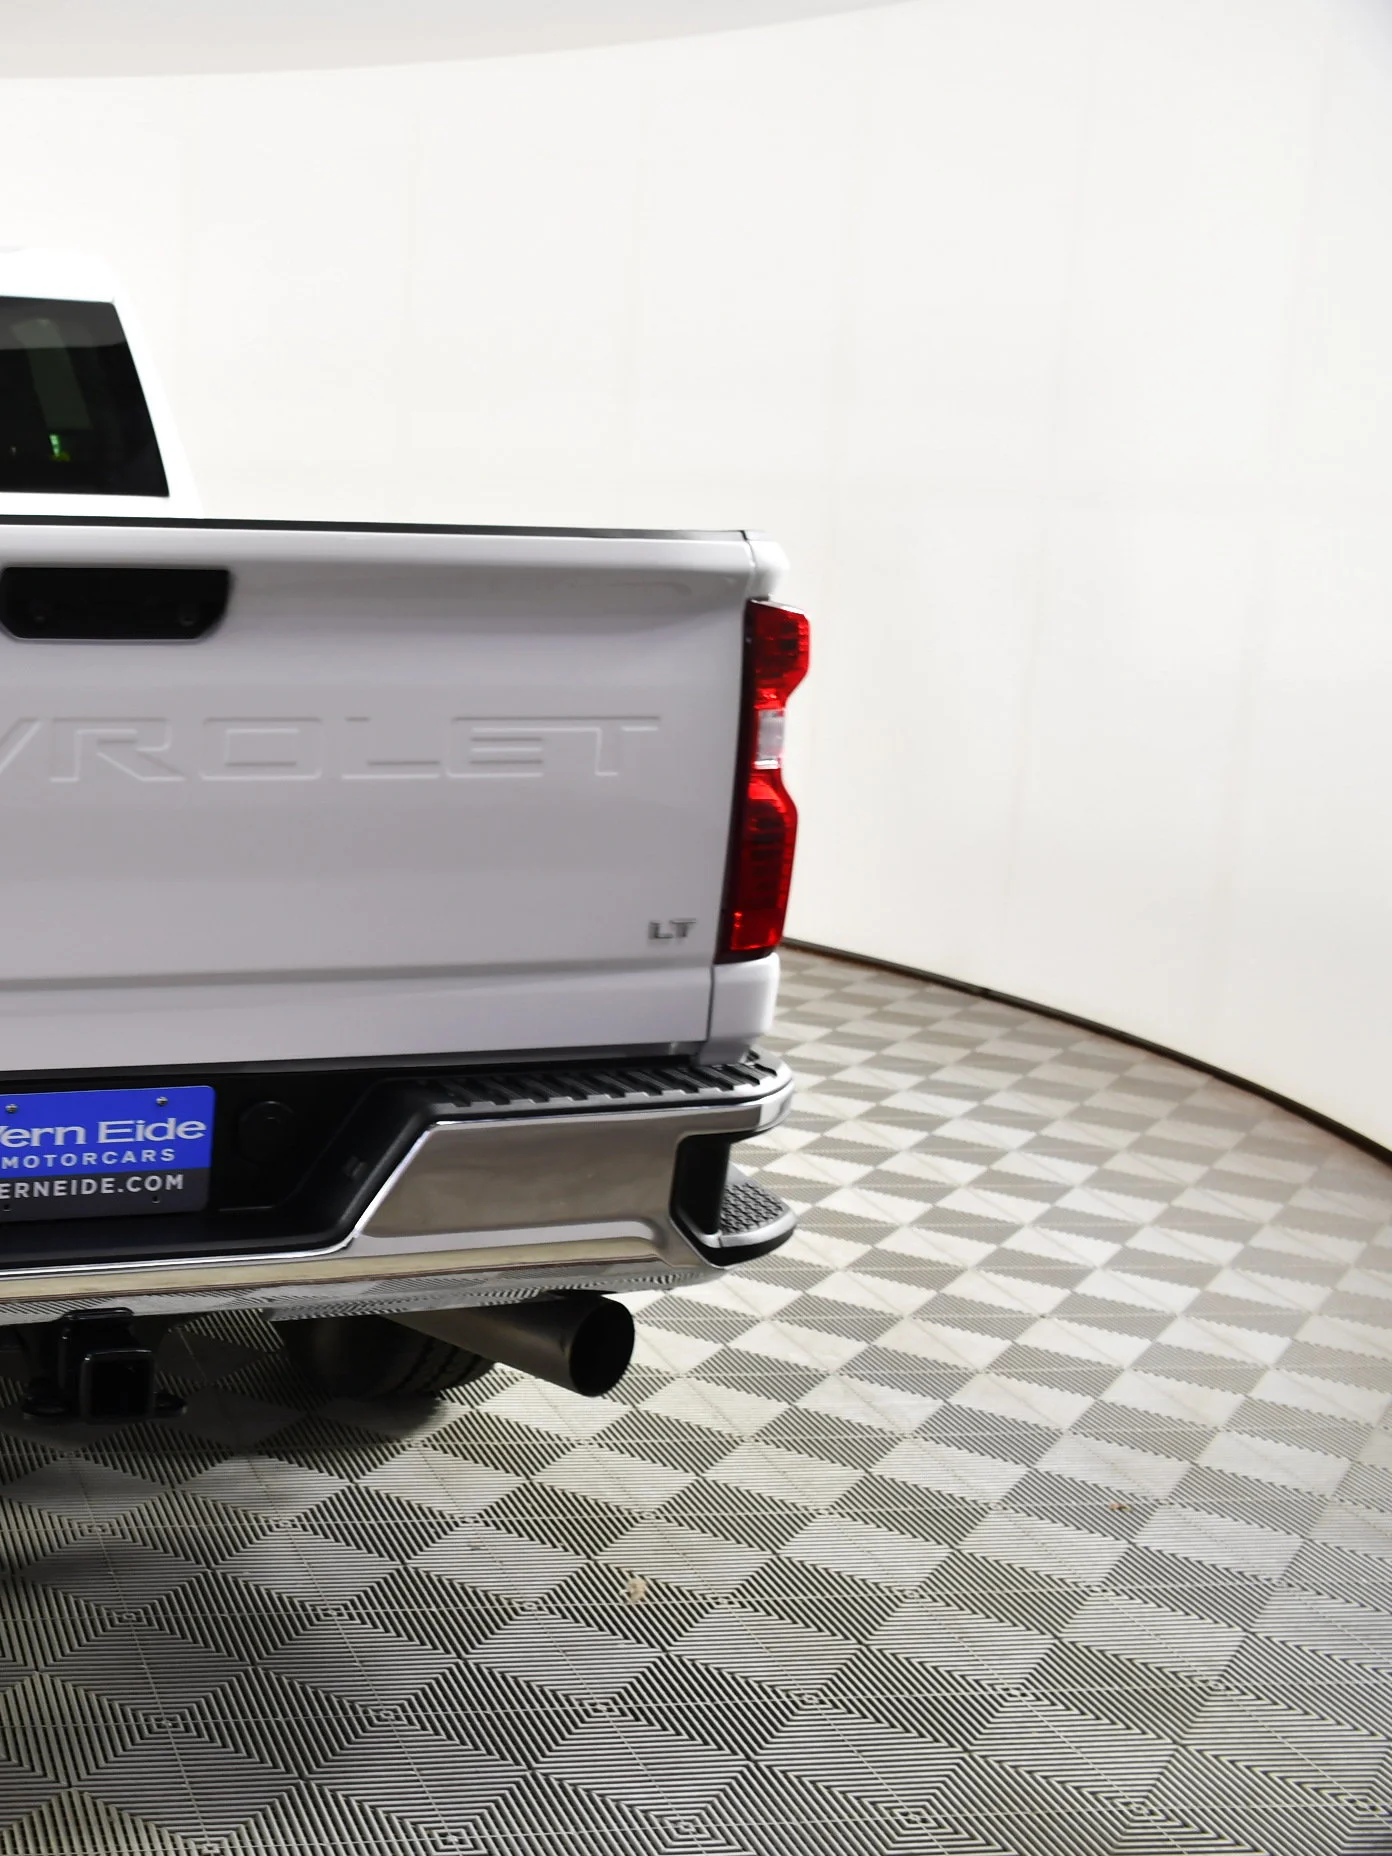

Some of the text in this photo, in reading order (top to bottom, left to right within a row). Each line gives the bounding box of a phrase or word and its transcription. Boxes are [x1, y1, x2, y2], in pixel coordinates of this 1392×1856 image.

[648, 918, 697, 940] LT
[97, 1117, 207, 1144] Eide
[1, 1148, 176, 1170] MOTORCARS
